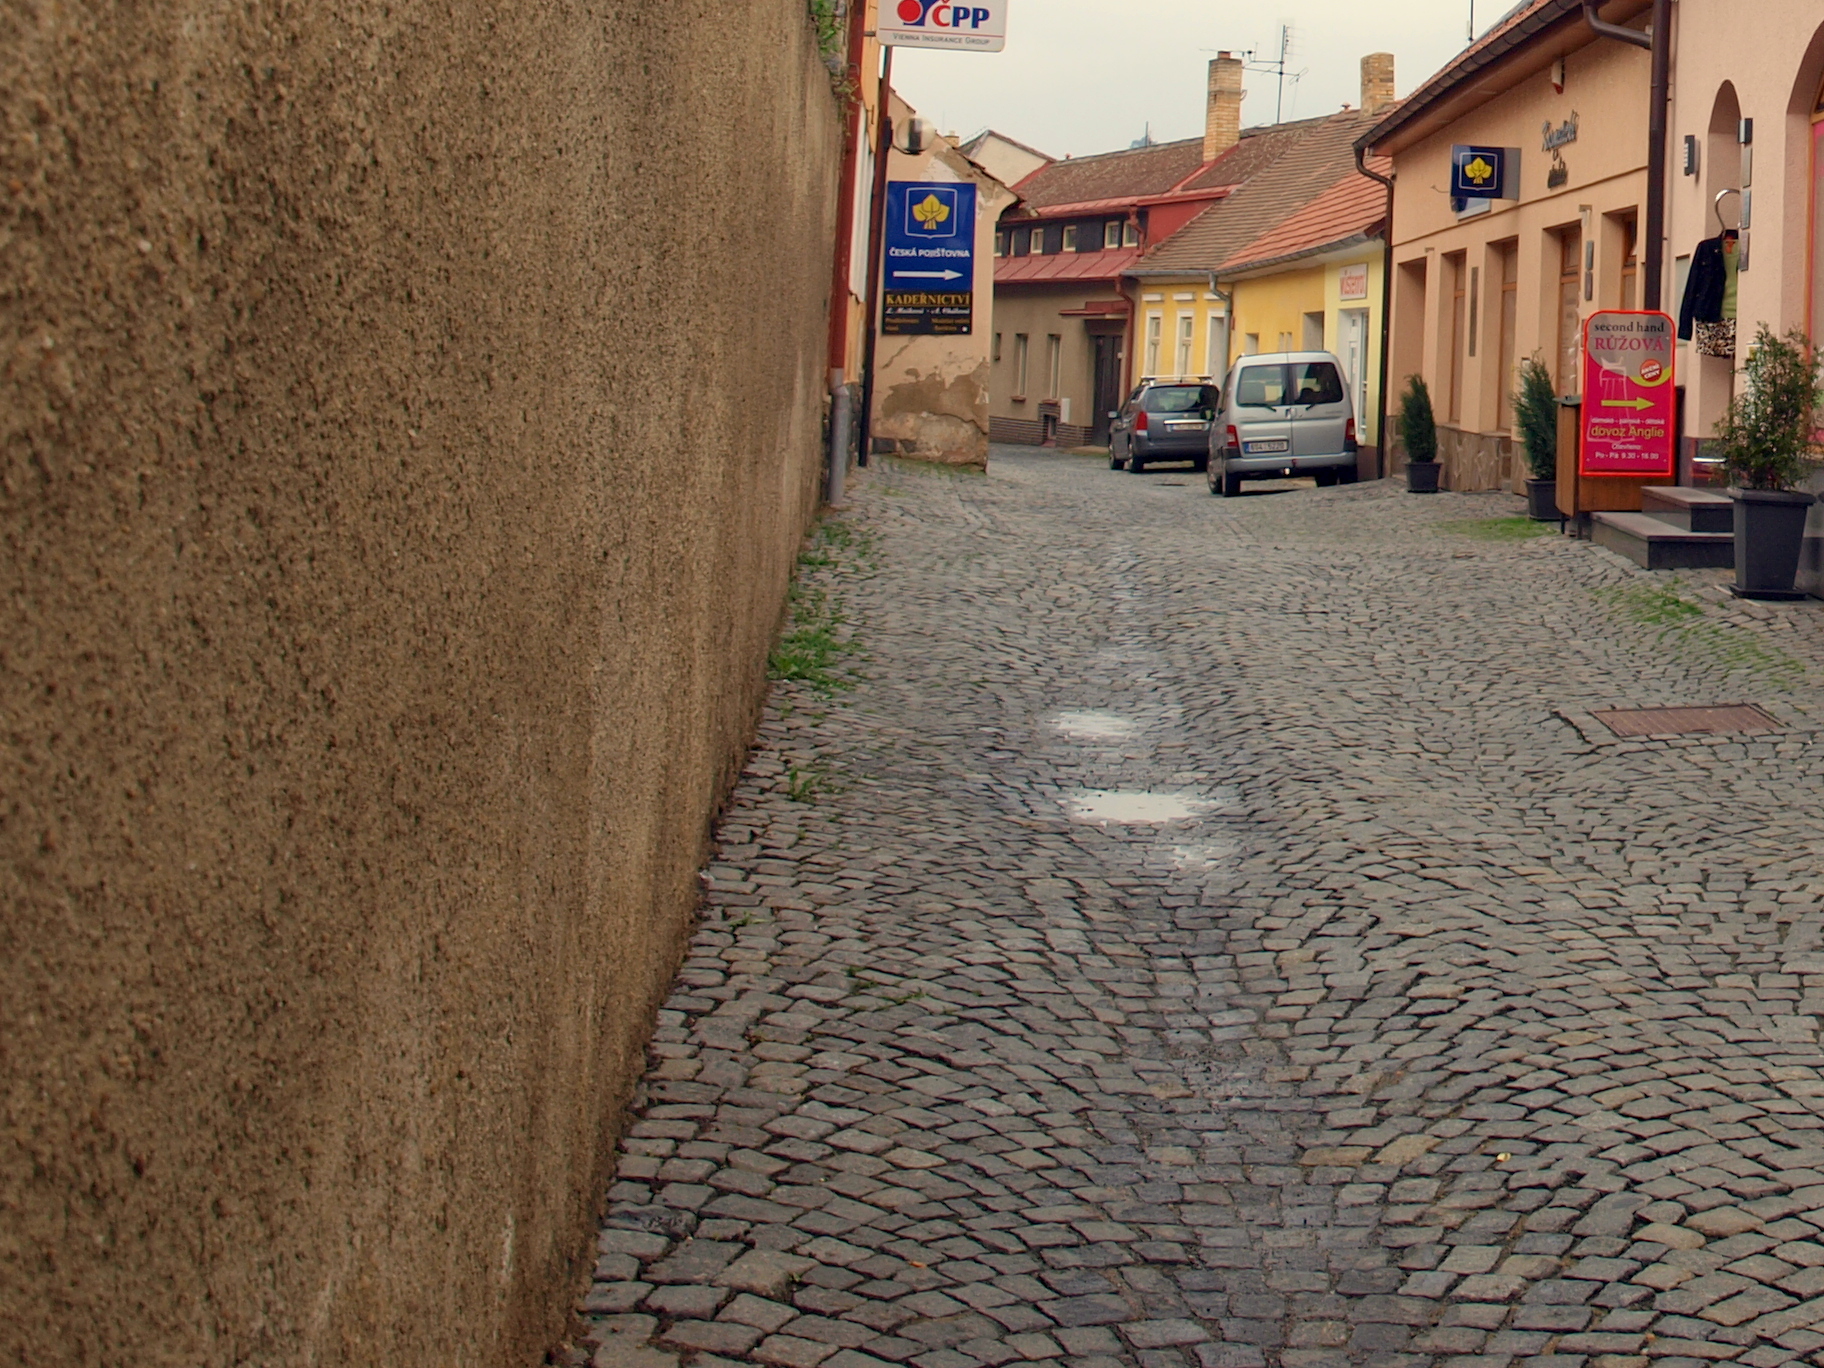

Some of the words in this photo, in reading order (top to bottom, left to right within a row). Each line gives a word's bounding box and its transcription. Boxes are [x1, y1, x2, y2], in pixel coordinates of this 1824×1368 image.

[889, 247, 917, 257] ČESKÁ
[918, 247, 971, 258] POJIŠŤOVNA
[886, 292, 970, 305] KADEŘNICTVÍ
[1594, 321, 1633, 333] second
[1636, 321, 1664, 333] hand
[1591, 425, 1626, 437] dovoz
[1629, 425, 1665, 439] Anglie
